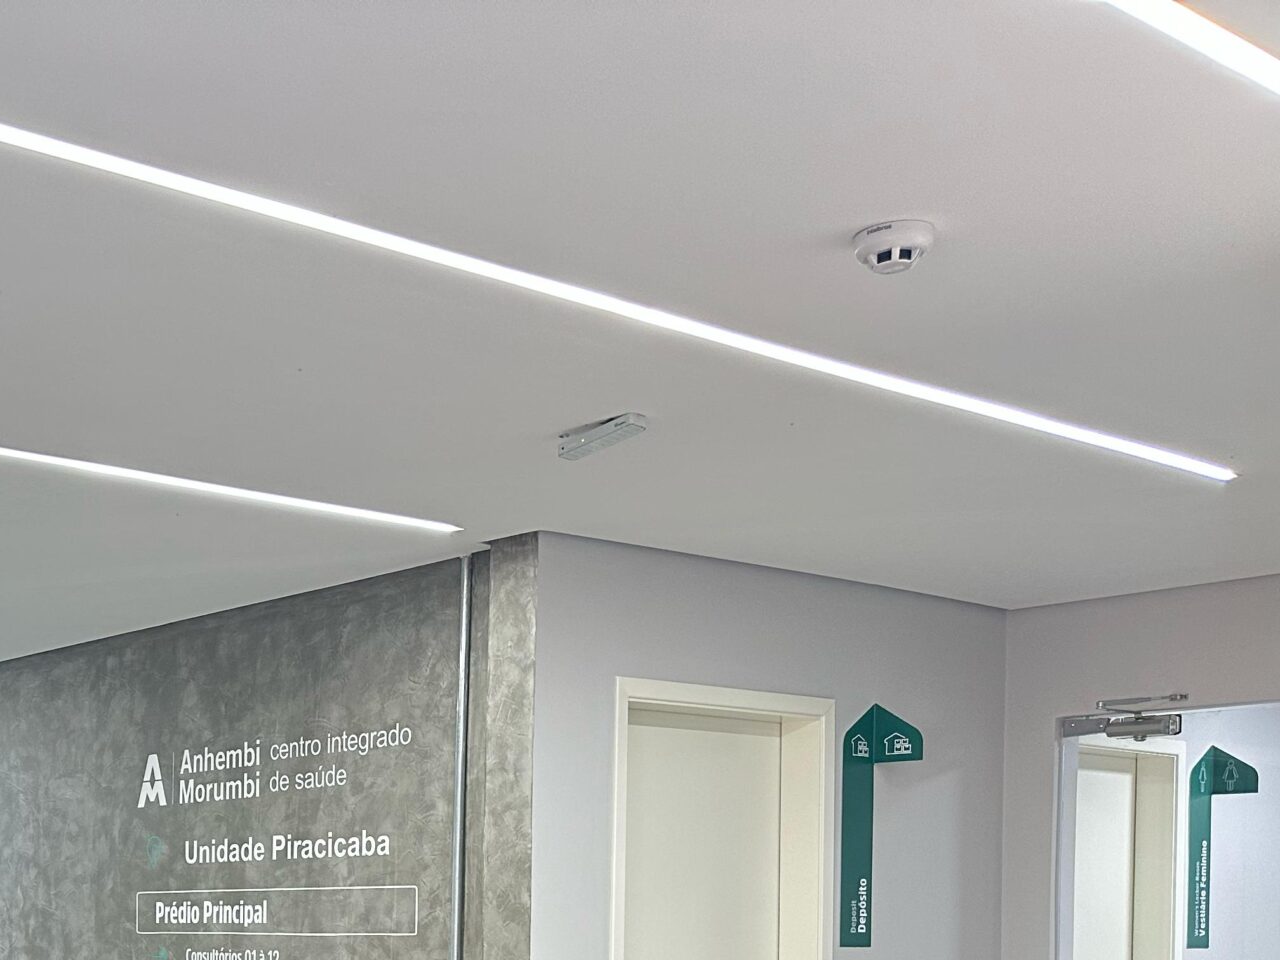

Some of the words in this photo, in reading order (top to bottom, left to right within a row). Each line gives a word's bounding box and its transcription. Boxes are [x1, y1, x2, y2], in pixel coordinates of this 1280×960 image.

[180, 740, 261, 775] Anhembi
[270, 737, 321, 761] centro
[327, 723, 412, 755] integrado
[179, 771, 261, 805] Morumbi
[270, 770, 290, 792] de
[295, 765, 347, 790] saúde
[185, 836, 265, 865] Unidade
[272, 829, 390, 861] Piracicaba
[1199, 840, 1207, 888] Feminino
[155, 901, 200, 924] Prédio
[203, 900, 267, 927] Principal
[857, 878, 867, 933] Depósito
[1199, 889, 1207, 937] Vestiário
